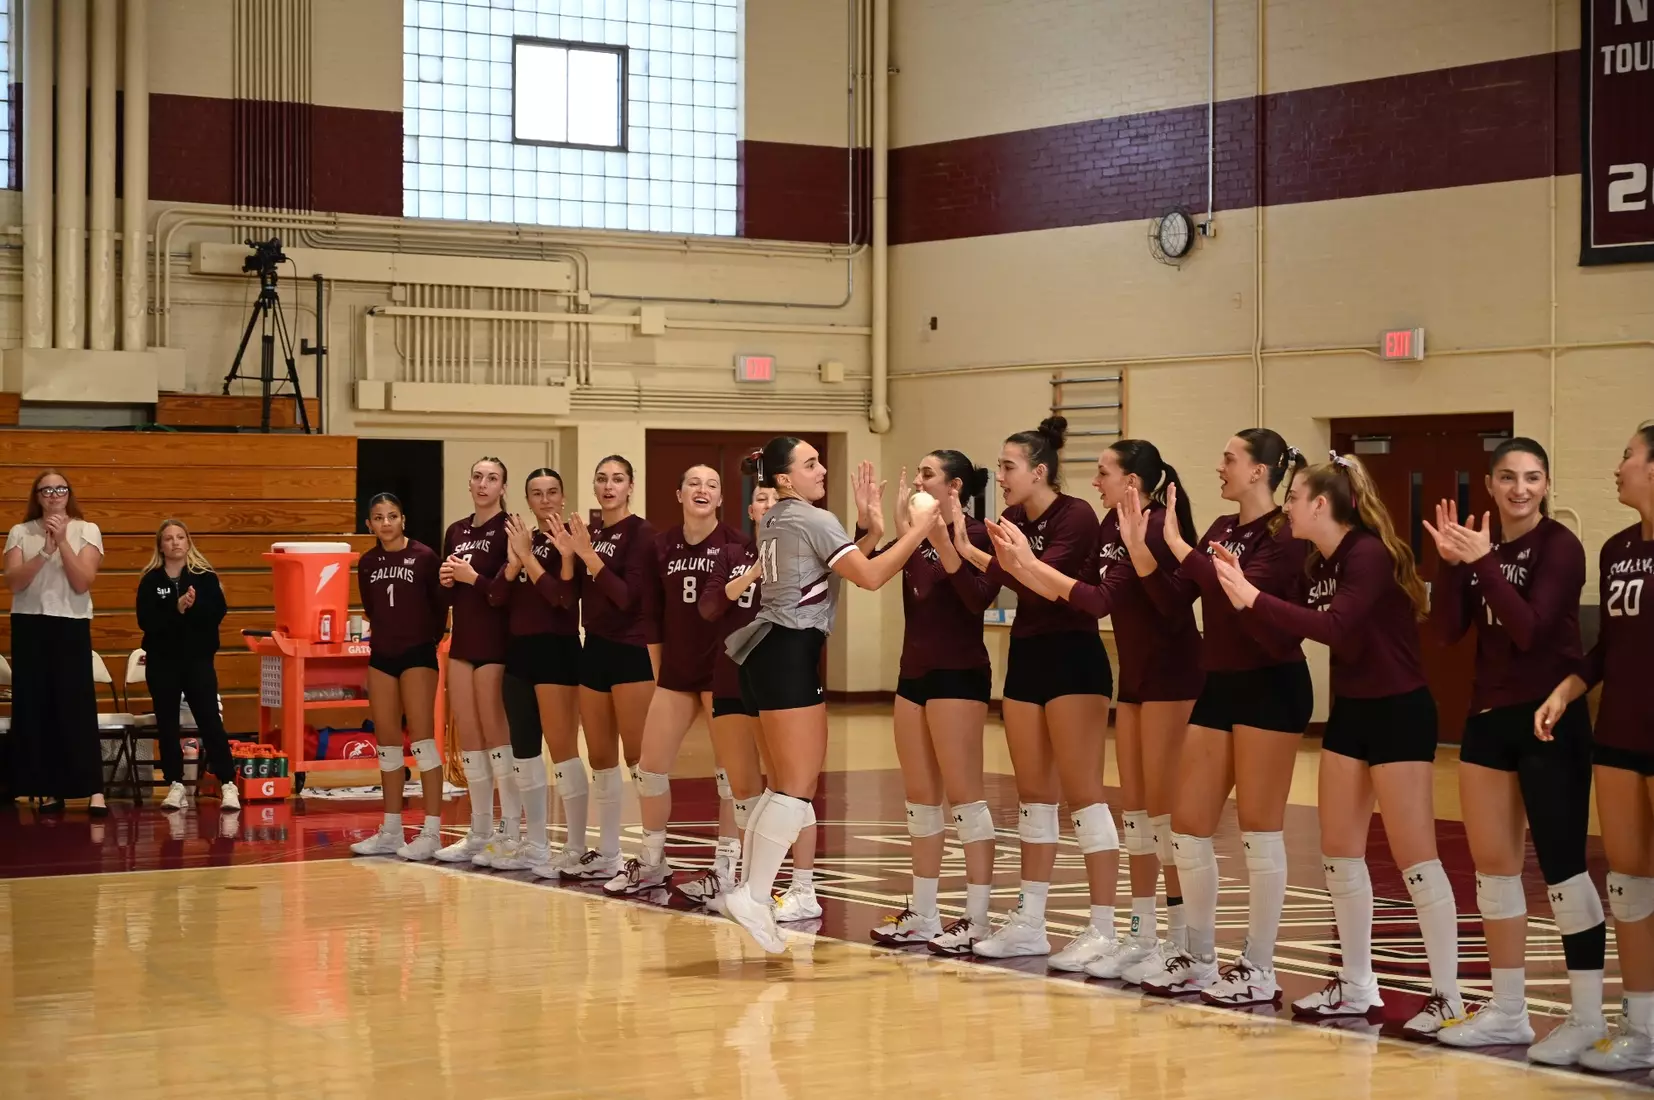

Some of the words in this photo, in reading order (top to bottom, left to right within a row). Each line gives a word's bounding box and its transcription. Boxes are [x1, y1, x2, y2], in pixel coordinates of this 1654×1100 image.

[1600, 41, 1654, 75] TOU
[1608, 163, 1654, 213] 2
[1386, 331, 1411, 357] EXIT
[455, 540, 490, 555] SALUKIS
[591, 541, 616, 557] LUKIS
[760, 537, 778, 584] 11
[370, 566, 414, 583] SALUKIS
[386, 583, 395, 607] 1
[683, 576, 697, 603] 8
[1607, 579, 1644, 617] 20
[347, 645, 371, 654] GATO
[244, 765, 253, 775] G
[259, 765, 269, 775] G
[262, 781, 275, 796] G
